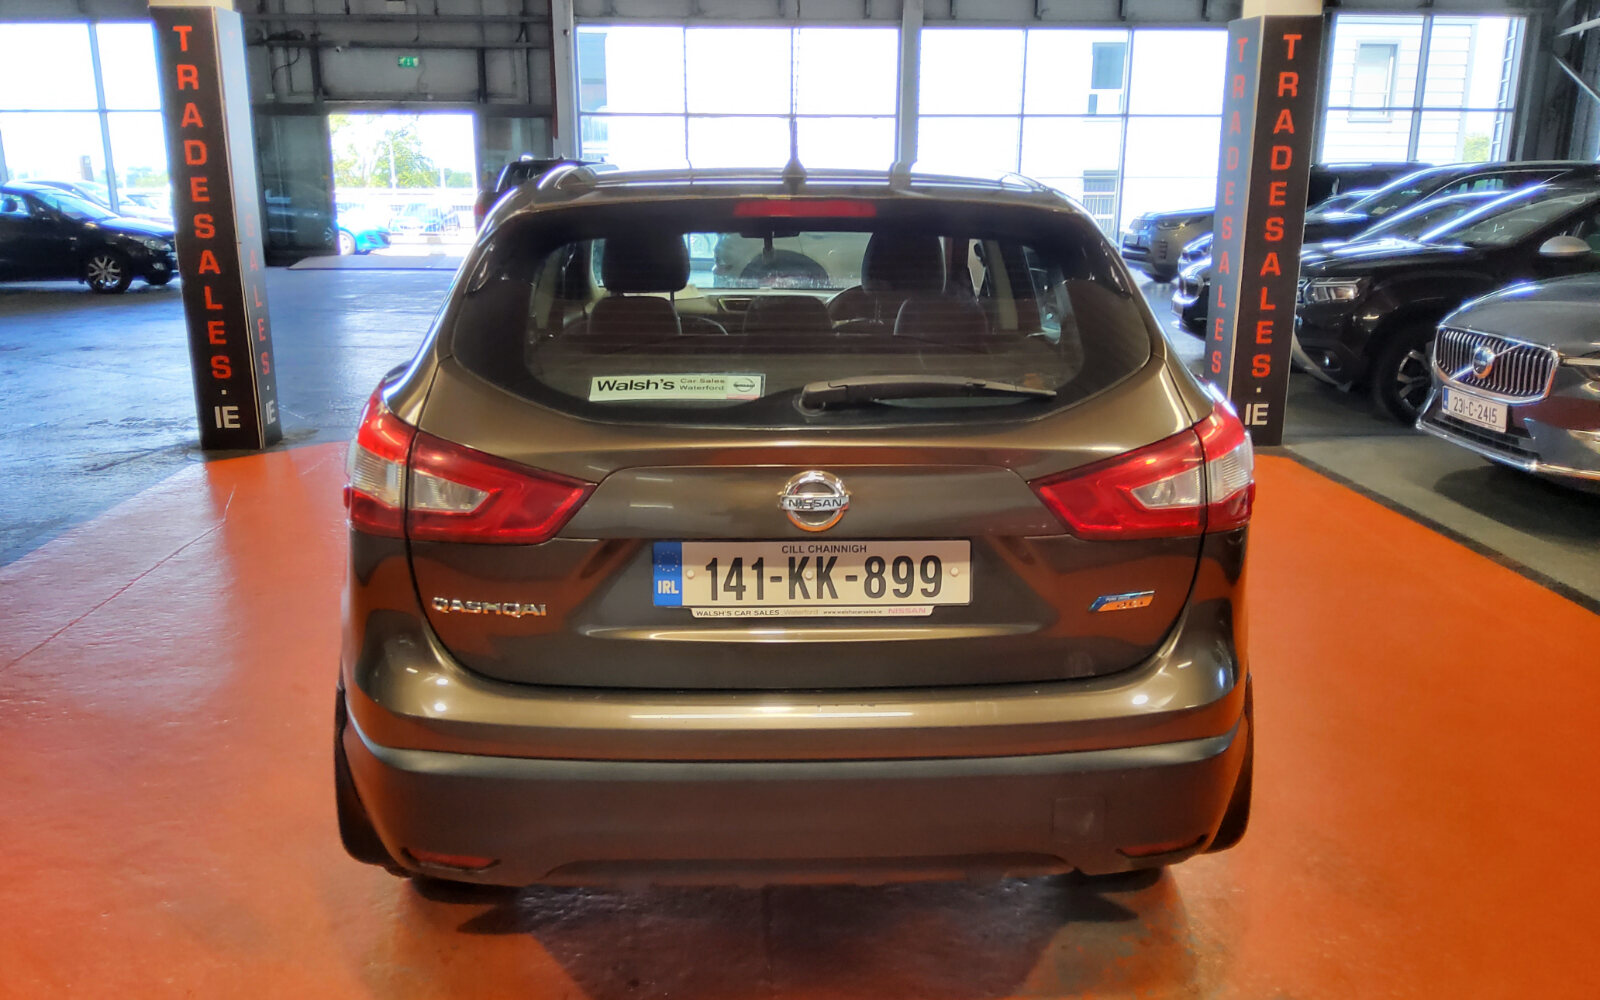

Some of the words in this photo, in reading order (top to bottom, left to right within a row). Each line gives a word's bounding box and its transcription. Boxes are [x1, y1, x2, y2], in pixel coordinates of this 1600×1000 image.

[597, 379, 675, 391] Walsh's
[788, 498, 842, 509] NISSAN
[781, 544, 805, 554] CILL
[808, 544, 867, 554] CHAINNIGH
[705, 555, 943, 601] 141-KK-899
[657, 580, 680, 594] IRL
[432, 597, 547, 618] QASHQAI
[696, 609, 732, 617] WALSH'S
